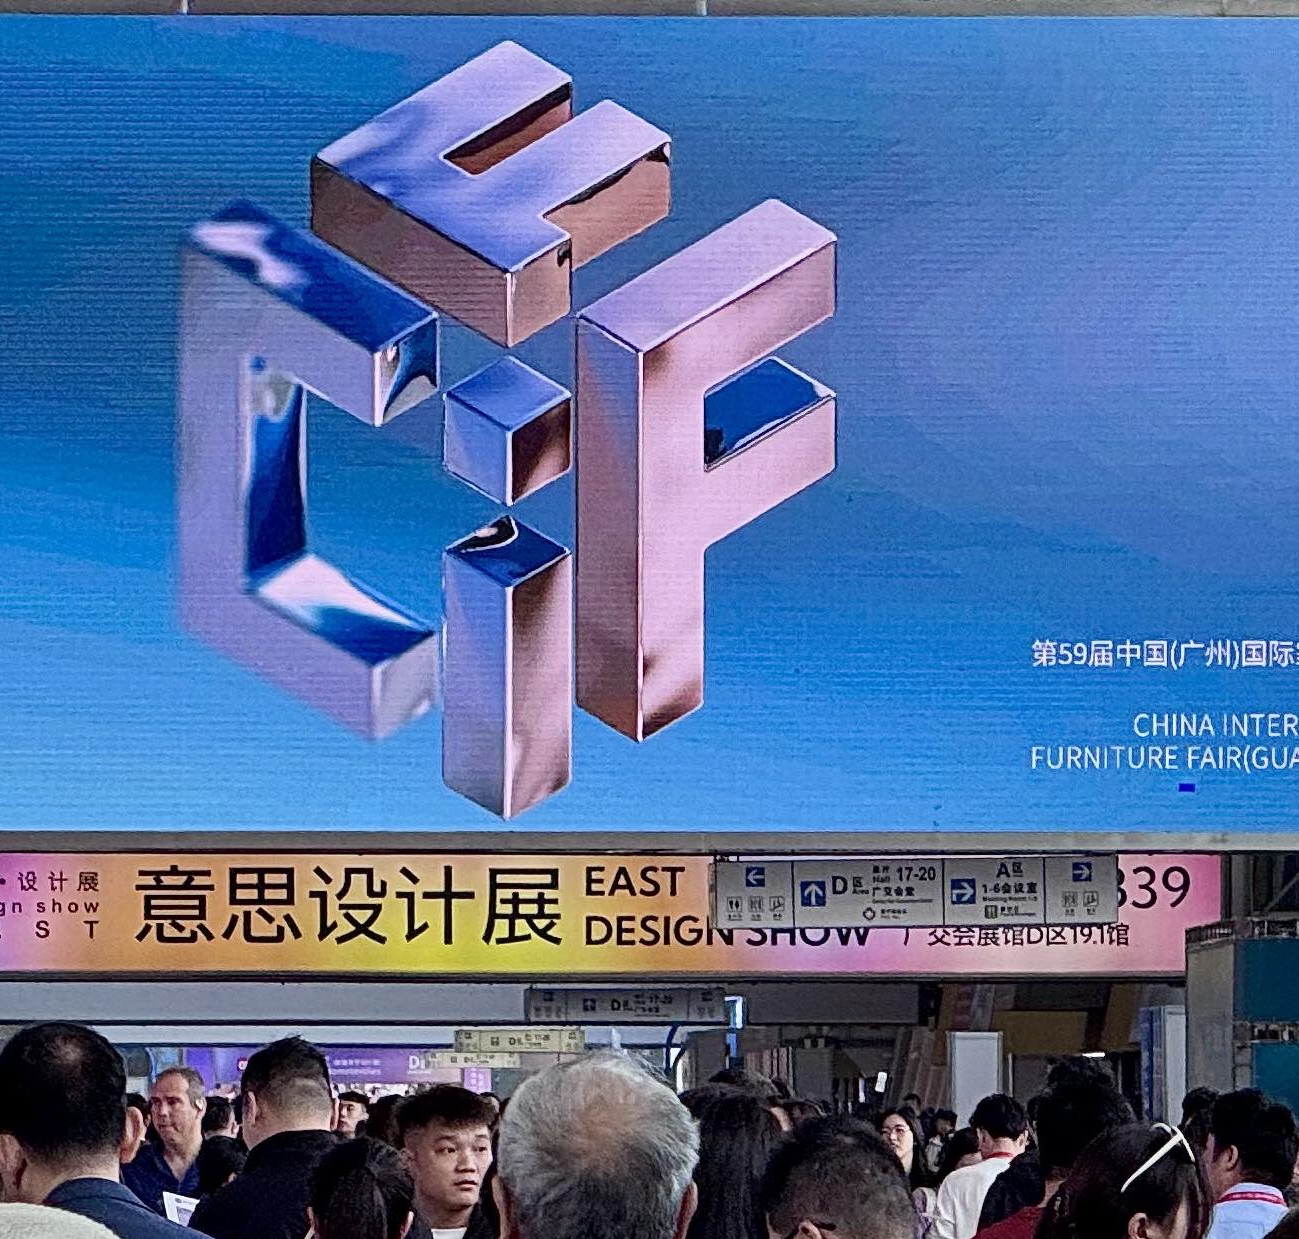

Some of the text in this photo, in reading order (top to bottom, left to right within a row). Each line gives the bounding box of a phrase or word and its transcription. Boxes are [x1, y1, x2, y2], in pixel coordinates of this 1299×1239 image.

[1132, 712, 1216, 739] CHINA
[1030, 745, 1179, 772] FURNITURE
[584, 865, 686, 897] EAST
[831, 875, 848, 895] D
[895, 866, 937, 882] 17-20
[35, 898, 100, 914] show
[134, 864, 563, 946] 意思设计展
[584, 915, 735, 947] DESIGN
[902, 924, 1130, 947] 交会展馆D区19.1馆
